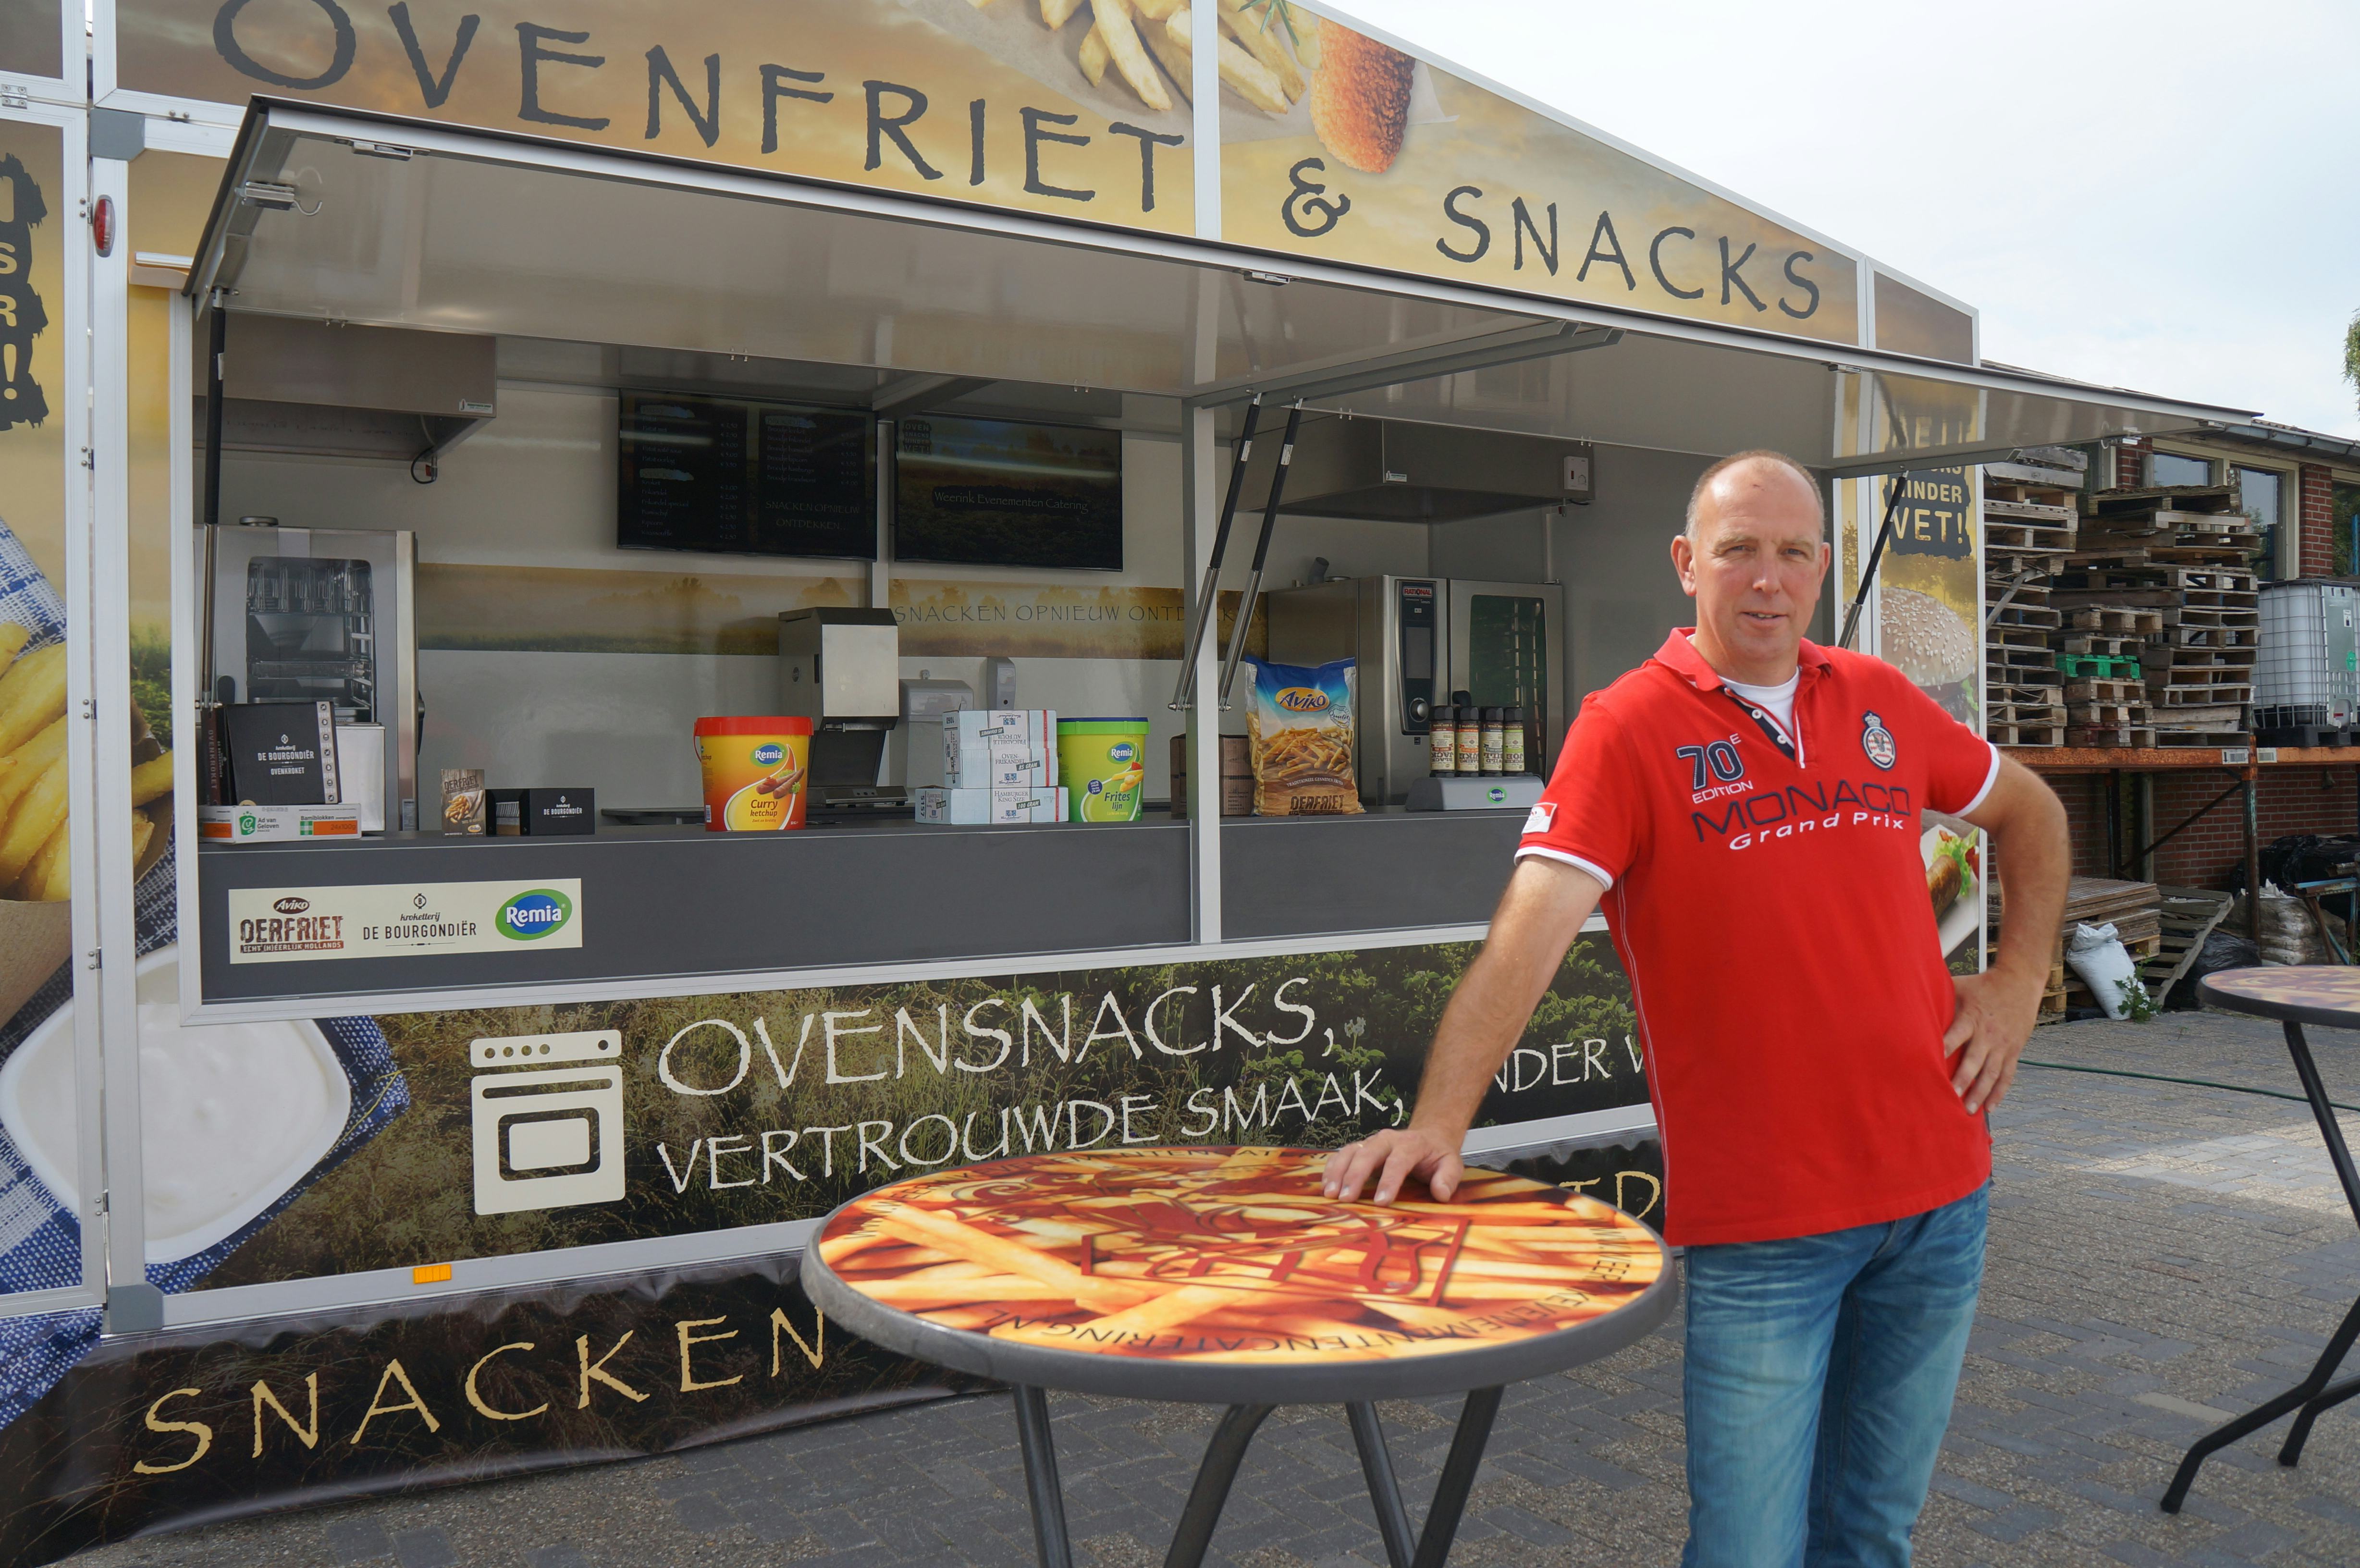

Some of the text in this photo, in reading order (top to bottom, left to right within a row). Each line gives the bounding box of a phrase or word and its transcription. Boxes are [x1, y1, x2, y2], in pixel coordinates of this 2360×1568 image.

[213, 0, 1820, 319] OVENFRIET & SNACKS
[905, 423, 929, 431] OVEN
[765, 500, 860, 514] SNACKEN OPNIEUW
[934, 491, 1088, 514] Weerink Evenementen Catering
[1893, 507, 1963, 544] VET!
[895, 605, 1006, 623] SNACKEN
[1016, 605, 1120, 622] OPNIEUW
[208, 730, 217, 789] OVENKROKET
[258, 749, 314, 761] DE BOURGONDIËR
[755, 750, 783, 760] Remia
[1111, 748, 1133, 759] Remia
[270, 767, 305, 775] OVENKROKET
[1105, 792, 1130, 801] Frites
[1692, 781, 1753, 804] EDITION
[551, 807, 582, 815] BOURGONDIËR
[751, 800, 778, 810] Curry
[1112, 802, 1122, 811] lijn
[1291, 795, 1344, 810] OERFRIET
[1691, 780, 1910, 842] MONACO
[750, 809, 778, 818] ketchup
[1730, 812, 1904, 850] Grand Prix
[400, 912, 441, 922] kroketterij
[506, 905, 562, 928] Remia
[241, 916, 344, 944] OERFRIET
[363, 921, 477, 941] DE BOURGONDIËR
[658, 977, 1334, 1096] OVENSNACKS,
[657, 1094, 1159, 1194] VERTROUWDE
[1181, 1067, 1404, 1137] SMAAK,
[133, 1306, 824, 1475] SNACKEN
